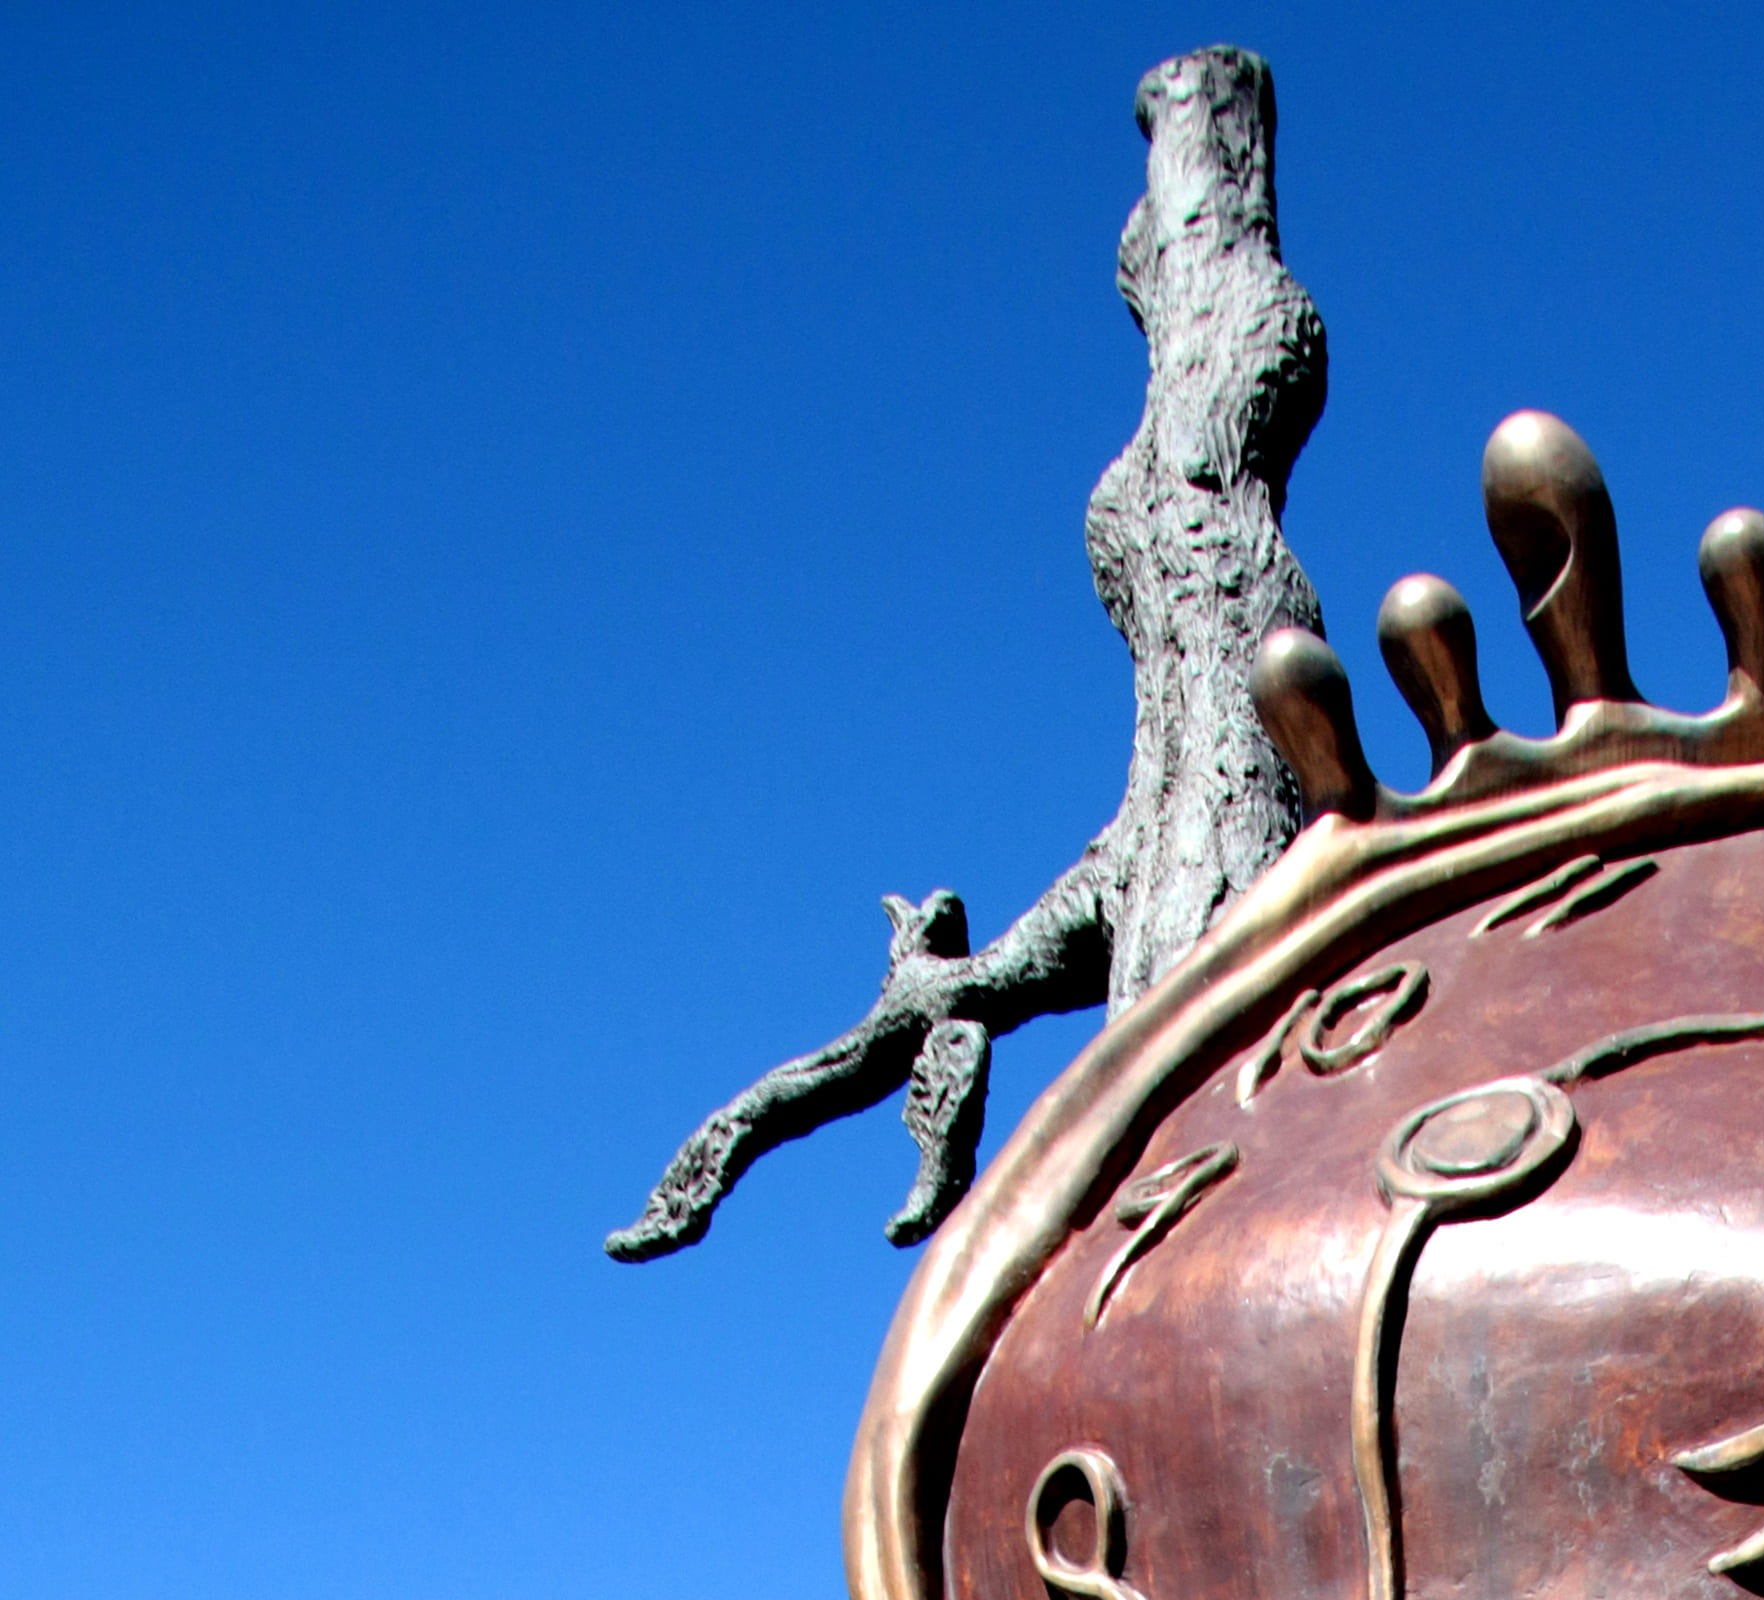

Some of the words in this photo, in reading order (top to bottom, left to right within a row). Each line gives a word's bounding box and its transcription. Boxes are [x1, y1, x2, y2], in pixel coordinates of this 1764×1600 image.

[1469, 853, 1658, 938] 11
[1238, 960, 1428, 1108] 10
[1083, 1140, 1240, 1332] 9
